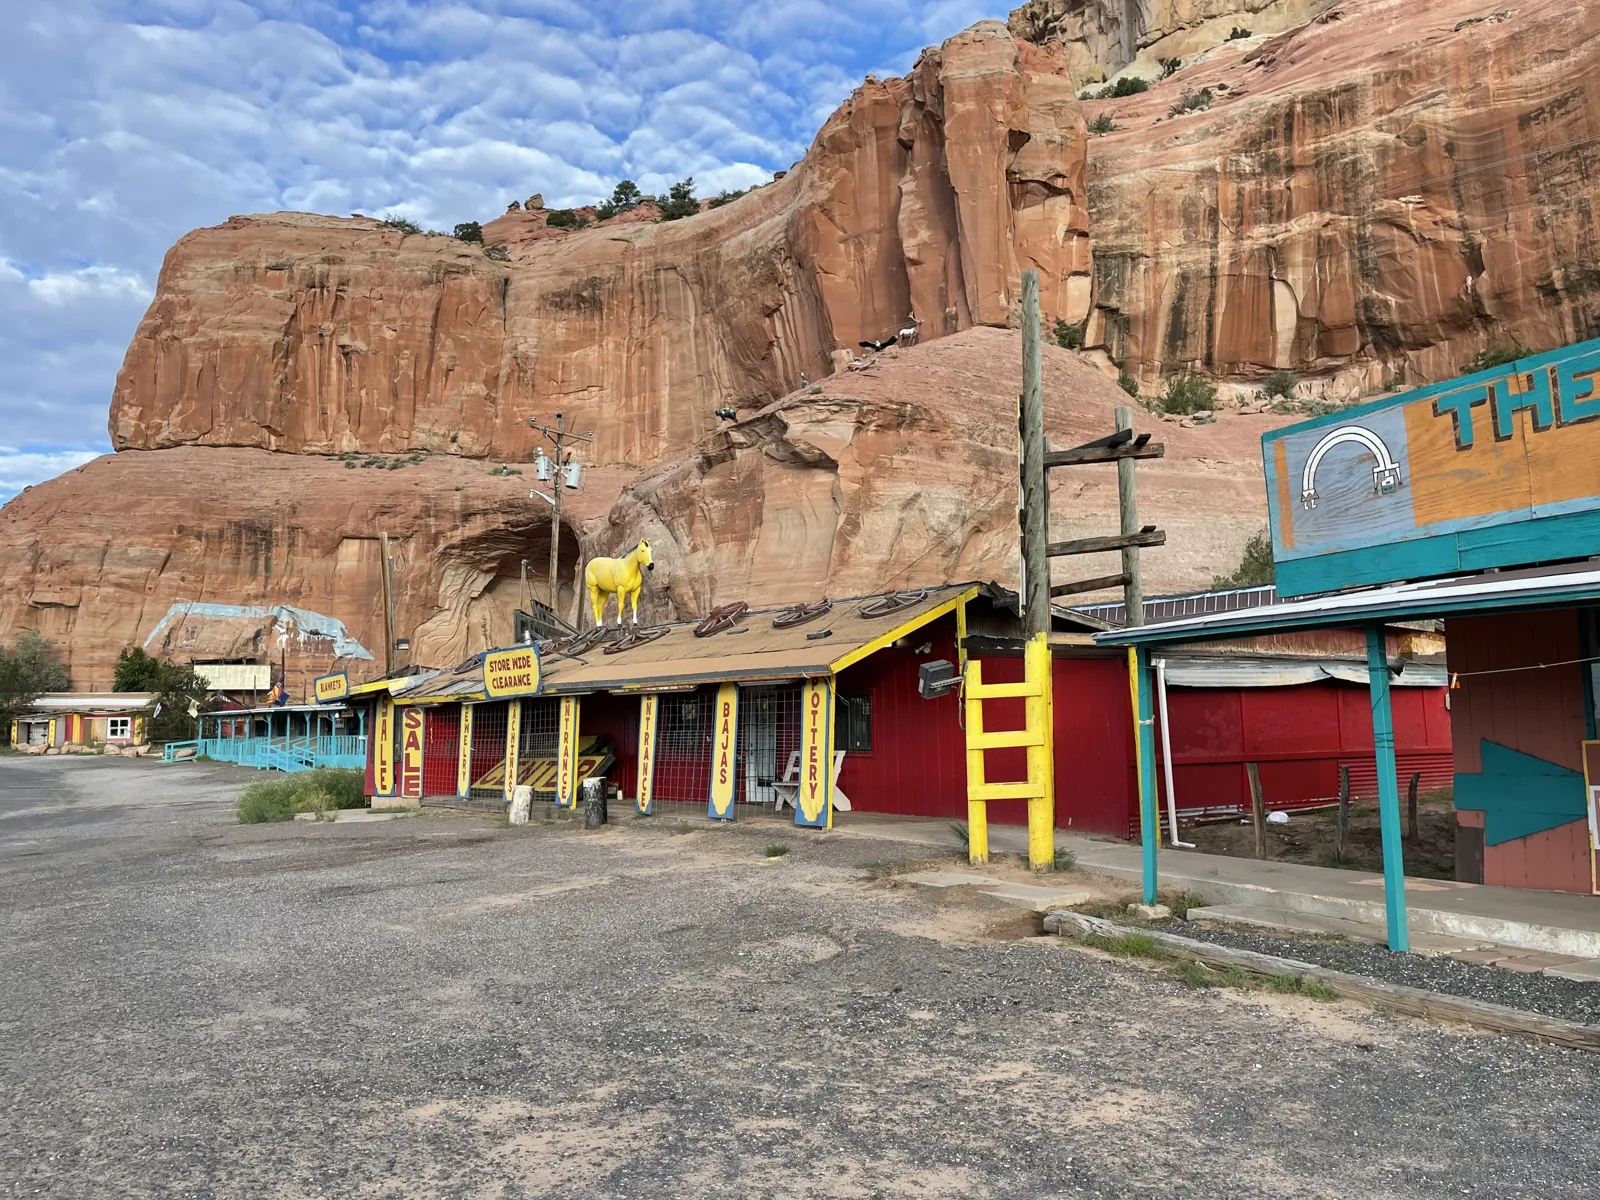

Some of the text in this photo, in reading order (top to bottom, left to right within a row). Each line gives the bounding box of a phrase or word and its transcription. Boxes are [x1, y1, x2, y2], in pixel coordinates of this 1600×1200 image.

[1432, 350, 1600, 452] THE
[320, 679, 341, 693] BLANKETS
[489, 655, 531, 672] STORE WIDE
[492, 674, 531, 689] CLEARANCE
[380, 694, 389, 791] SALE
[403, 708, 422, 797] SALE
[561, 696, 571, 799] ENTRANCE
[641, 694, 652, 807] ENTRANCE
[719, 701, 731, 785] BAJAS
[809, 677, 820, 800] POTTERY
